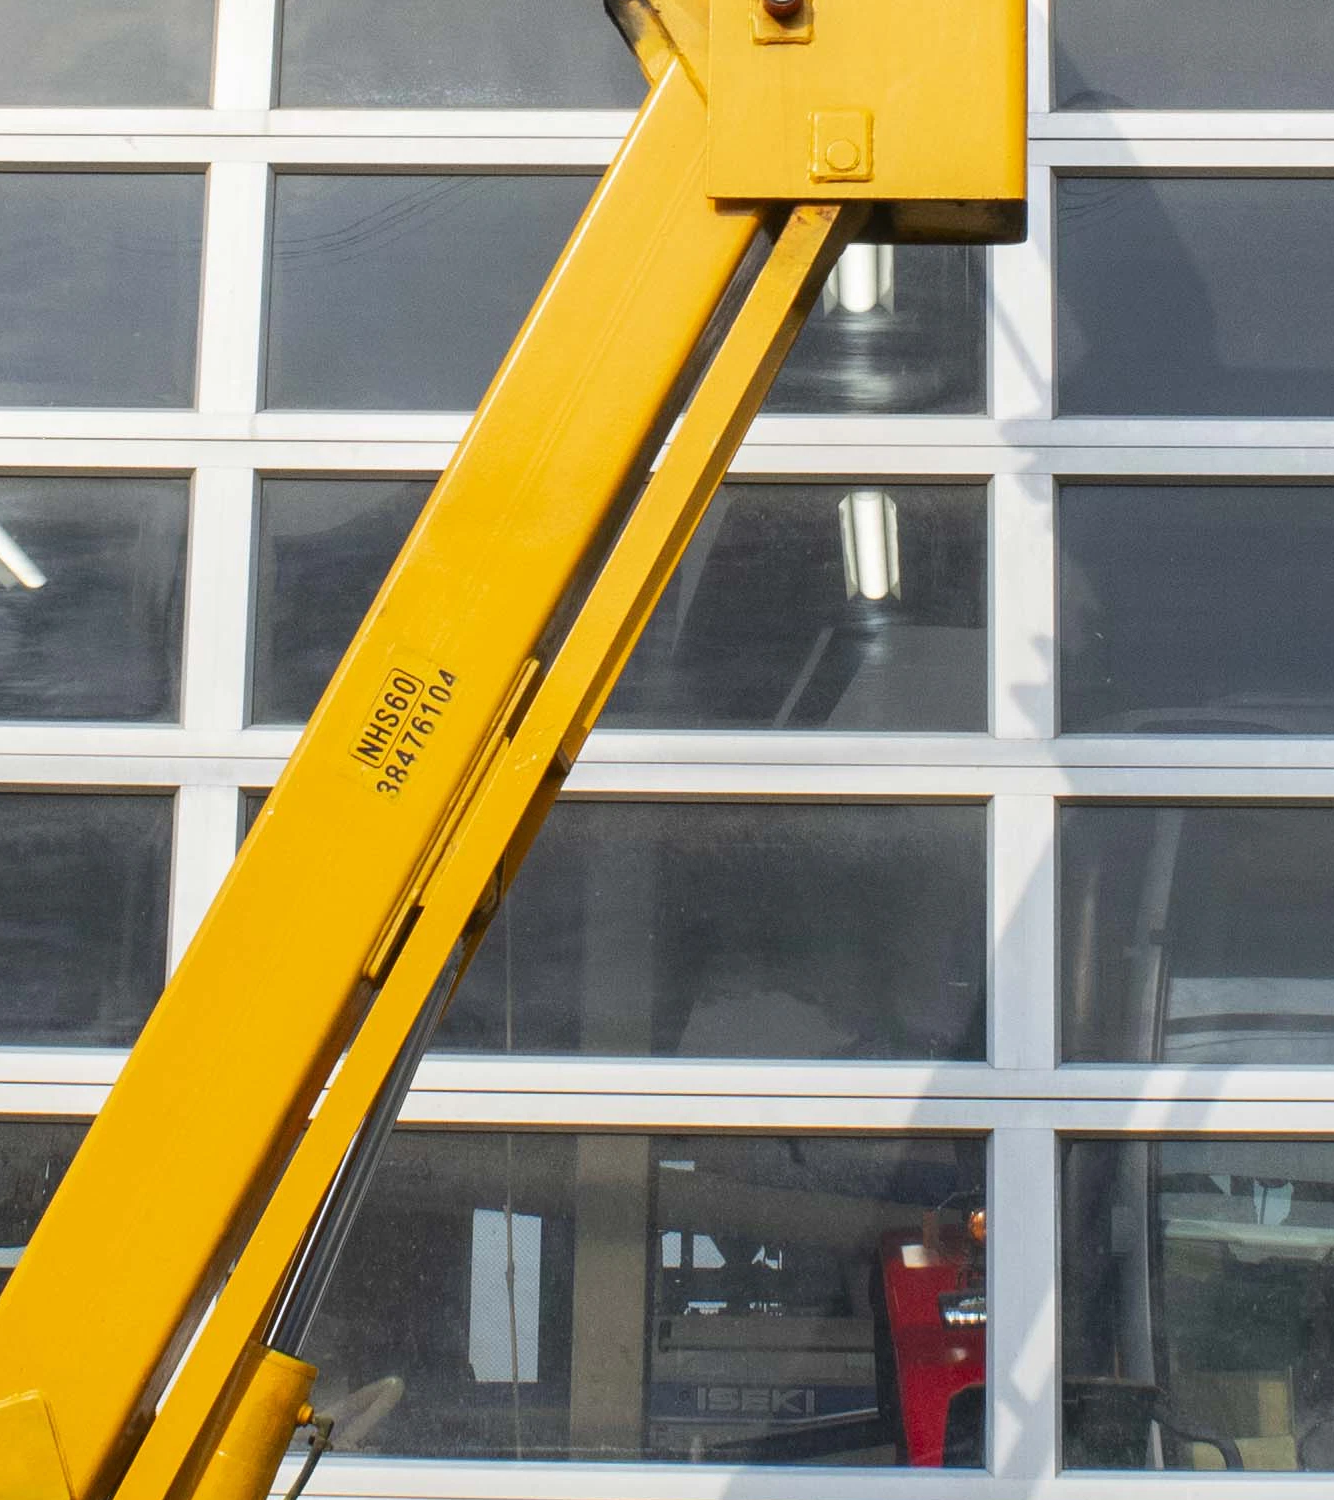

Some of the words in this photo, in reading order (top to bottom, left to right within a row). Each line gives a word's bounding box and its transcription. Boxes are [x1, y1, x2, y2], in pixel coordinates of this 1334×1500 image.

[356, 676, 417, 762] NHS60
[376, 668, 457, 797] 38476104
[697, 1387, 816, 1416] ISEKI
